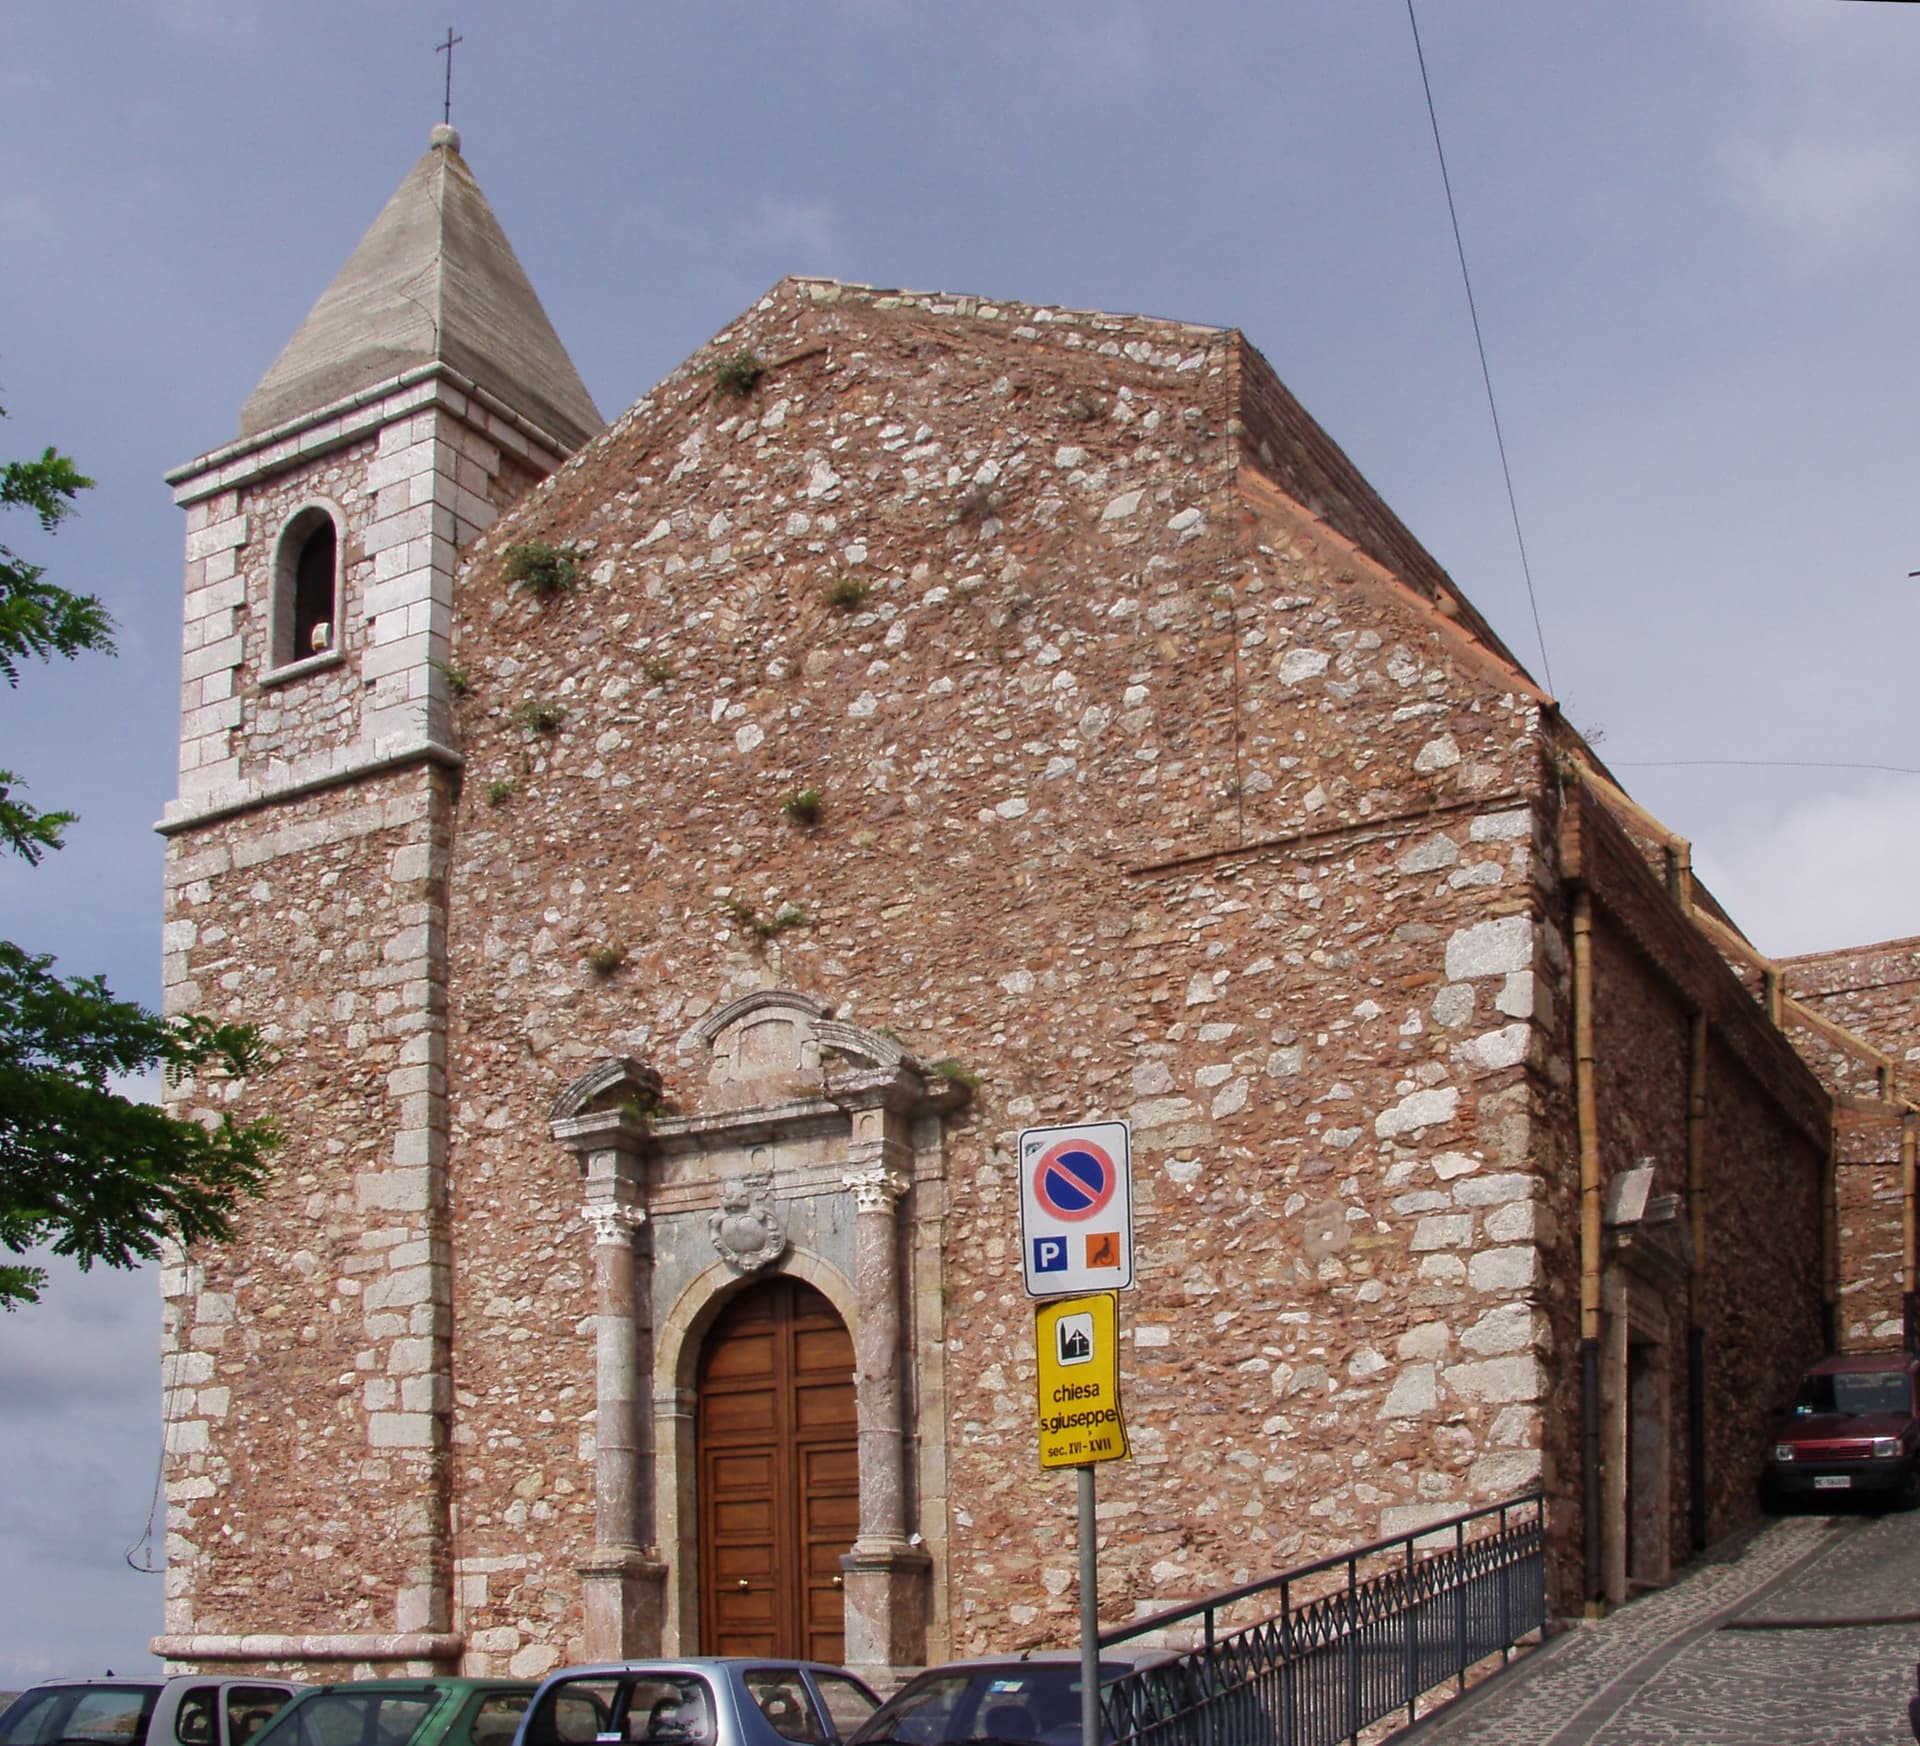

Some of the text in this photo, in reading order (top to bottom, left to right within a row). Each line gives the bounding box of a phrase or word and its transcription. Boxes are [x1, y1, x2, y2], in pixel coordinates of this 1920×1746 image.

[1040, 1242, 1060, 1268] P
[1053, 1382, 1100, 1403] chiesa
[1047, 1445, 1068, 1458] sec.
